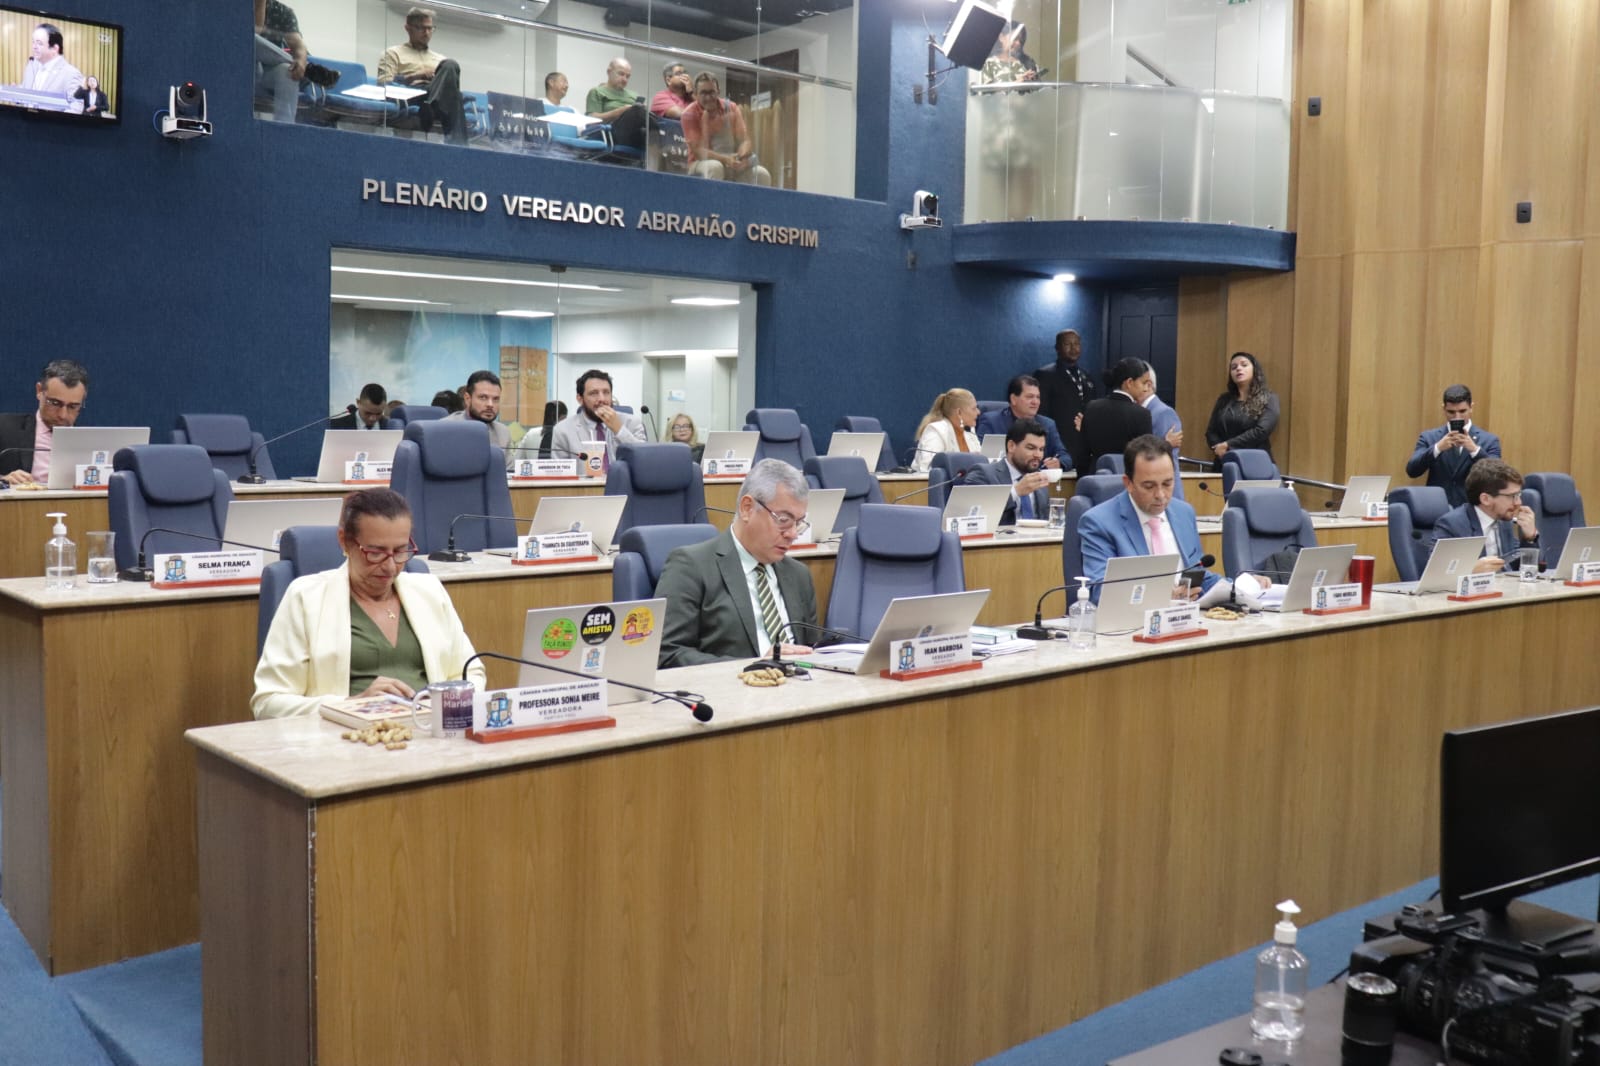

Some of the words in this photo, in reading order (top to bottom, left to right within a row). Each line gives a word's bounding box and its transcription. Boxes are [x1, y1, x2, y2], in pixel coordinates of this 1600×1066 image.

[363, 178, 488, 212] PLENÁRIO
[502, 194, 625, 227] VEREADOR
[637, 210, 736, 239] ABRAHÃO
[747, 223, 819, 248] CRISPIM
[198, 561, 221, 569] SELMA
[223, 560, 251, 568] FRANÇA
[586, 612, 611, 626] SEM
[925, 647, 937, 655] IRAN
[938, 644, 963, 653] BARBOSA
[519, 696, 560, 710] PROFESSORA
[581, 692, 601, 702] MEIRE
[538, 705, 582, 716] VEREADORA
